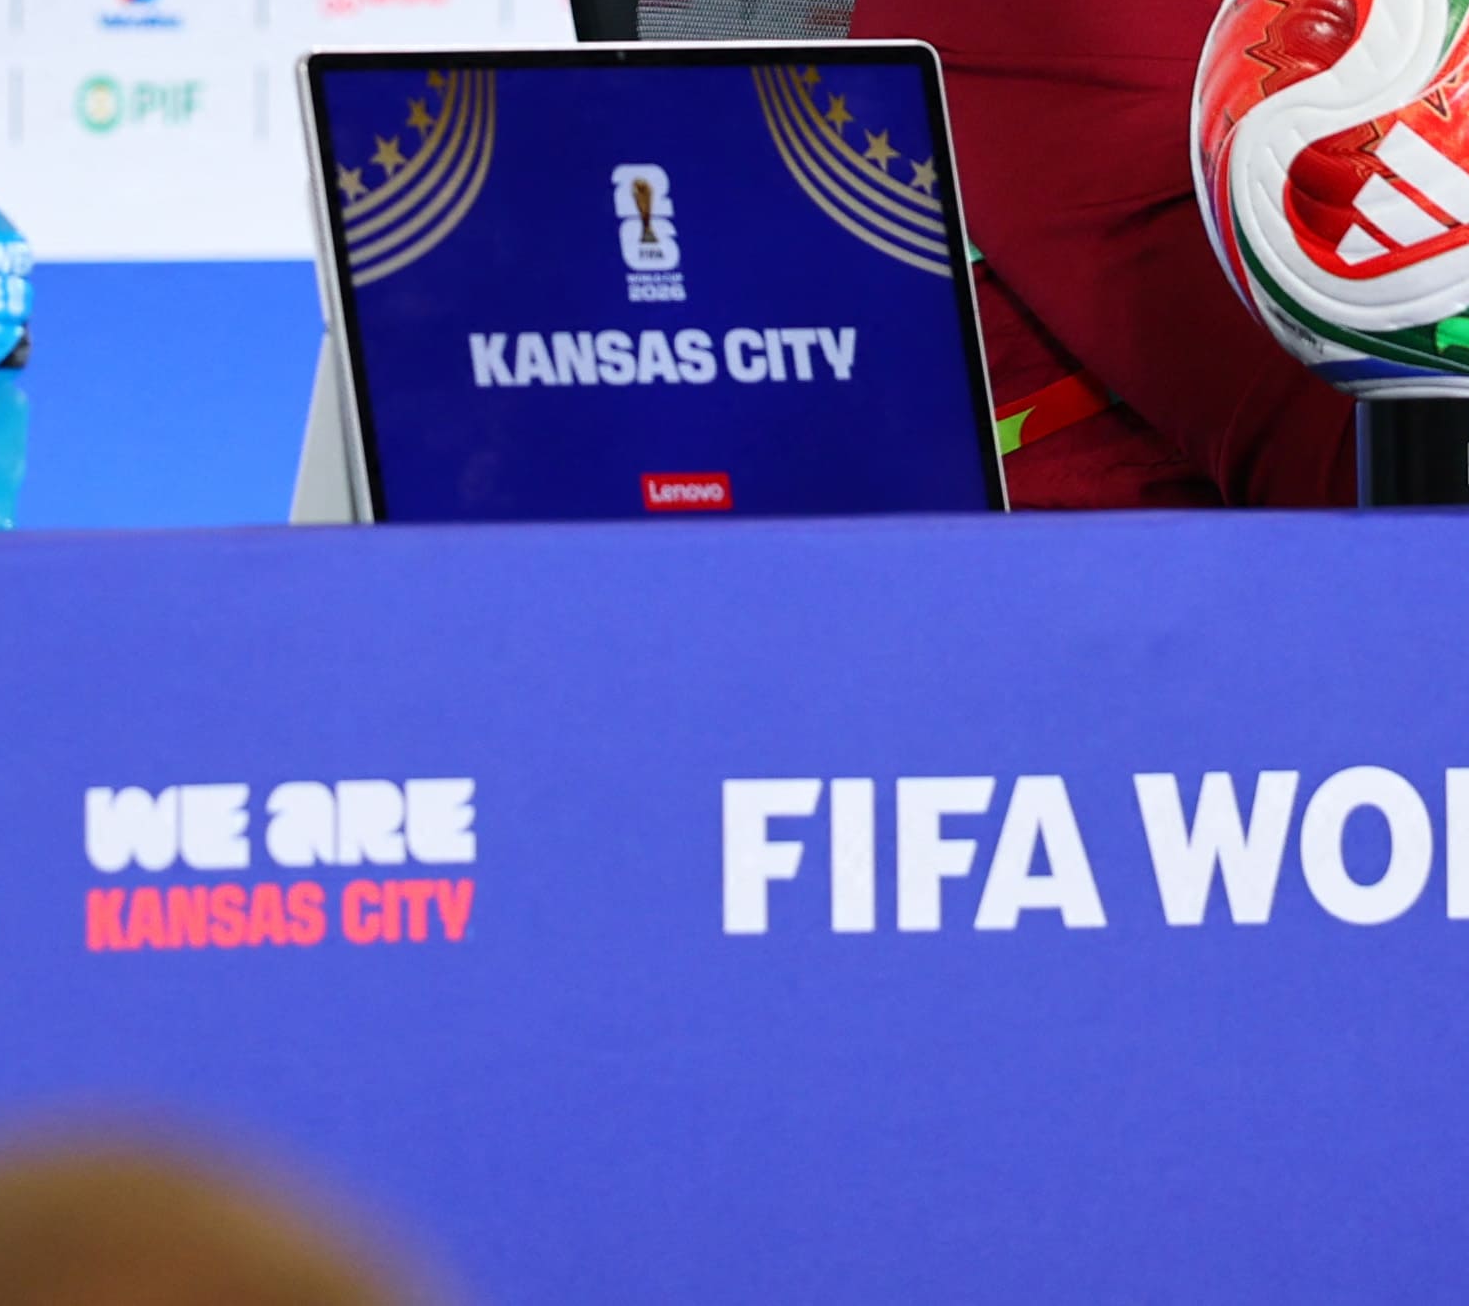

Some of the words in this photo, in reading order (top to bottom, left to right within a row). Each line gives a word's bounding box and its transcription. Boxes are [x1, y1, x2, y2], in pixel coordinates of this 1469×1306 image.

[469, 330, 716, 387] KANSAS
[723, 326, 858, 383] CITY
[648, 481, 725, 505] Lenovo
[84, 782, 251, 872] WE
[722, 774, 1108, 935] FIFA
[85, 881, 328, 952] KANSAS
[340, 878, 475, 945] CITY
